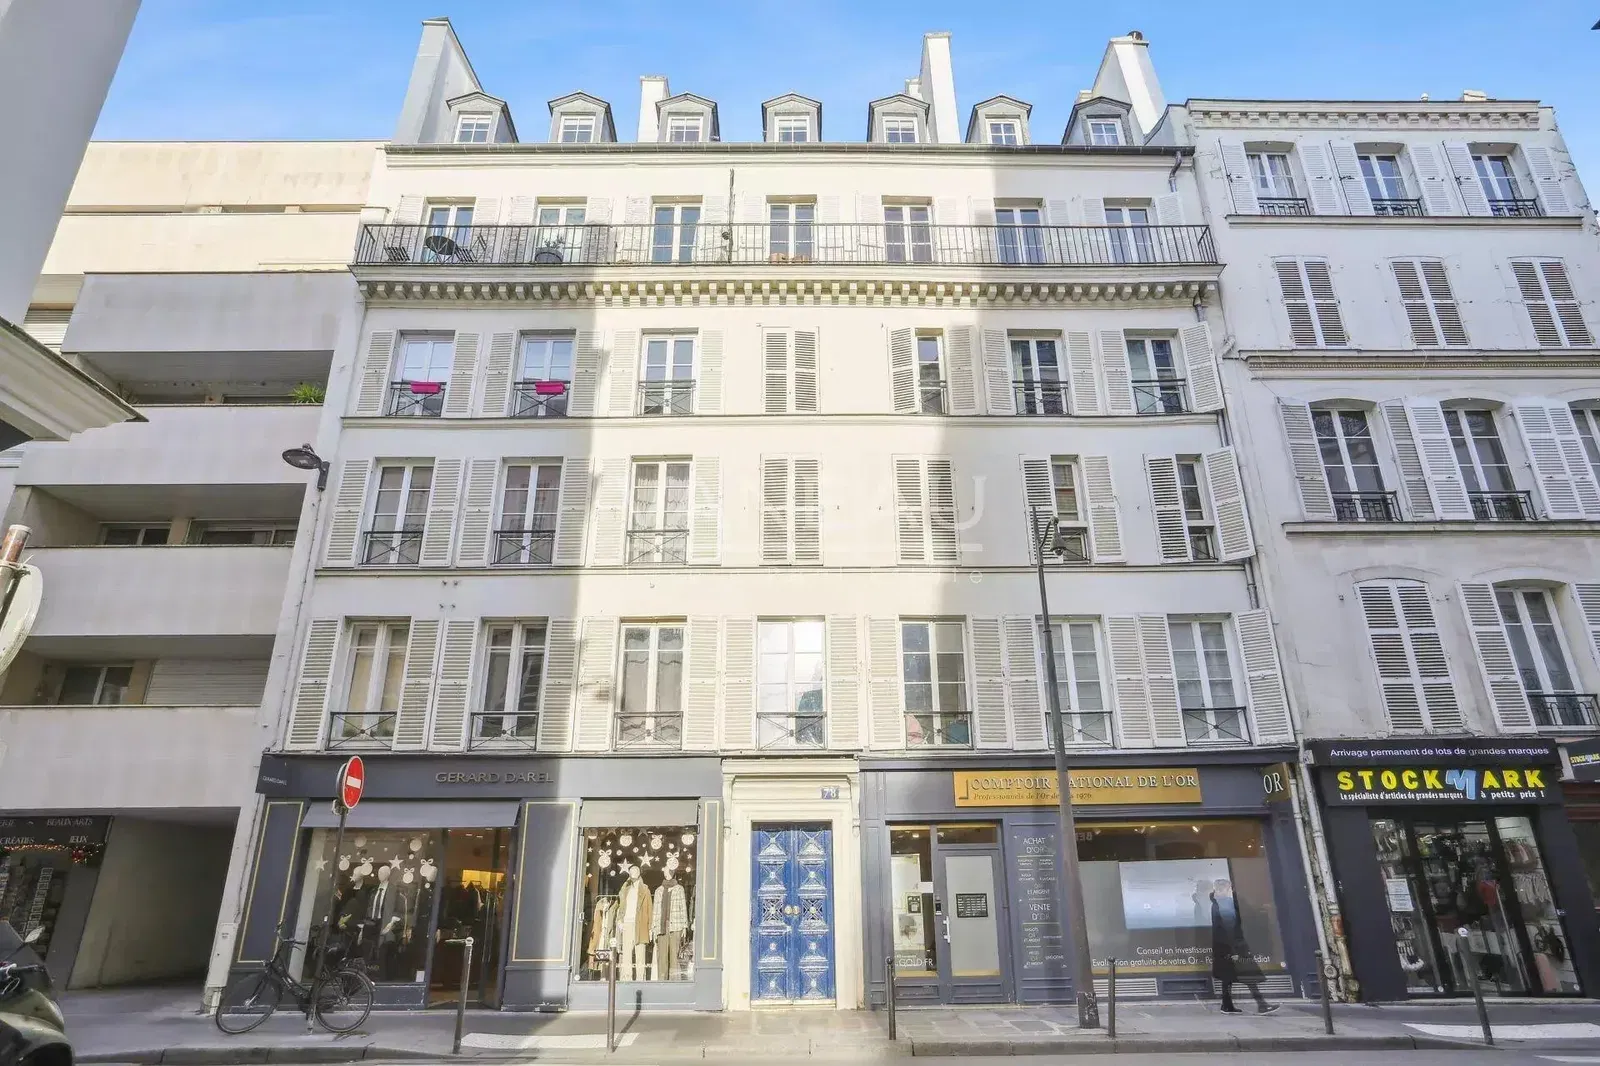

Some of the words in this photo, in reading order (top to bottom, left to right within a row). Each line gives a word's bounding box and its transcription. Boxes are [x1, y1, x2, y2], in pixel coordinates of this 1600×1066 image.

[1330, 749, 1369, 757] Arrivage
[1371, 748, 1420, 757] permanent
[1421, 748, 1434, 756] de
[1468, 748, 1506, 756] grandes
[1508, 748, 1550, 756] marques
[435, 772, 500, 783] GERARD
[505, 771, 554, 783] DAREL
[971, 777, 1051, 790] COMPTOIR
[1137, 776, 1158, 787] DE
[1163, 774, 1197, 787] L'OR
[1263, 772, 1284, 794] OR
[823, 787, 837, 798] 78
[1027, 790, 1035, 799] de
[1416, 792, 1439, 801] grandes
[1439, 792, 1463, 800] marques
[1491, 791, 1516, 800] petits
[1520, 791, 1537, 800] prix
[69, 835, 88, 844] JEUX
[1023, 837, 1046, 845] ACHAT
[1029, 903, 1051, 911] VENTE
[1136, 946, 1163, 955] Conseil
[1130, 959, 1157, 968] gratuite
[1158, 957, 1168, 965] de
[1187, 956, 1198, 965] Or
